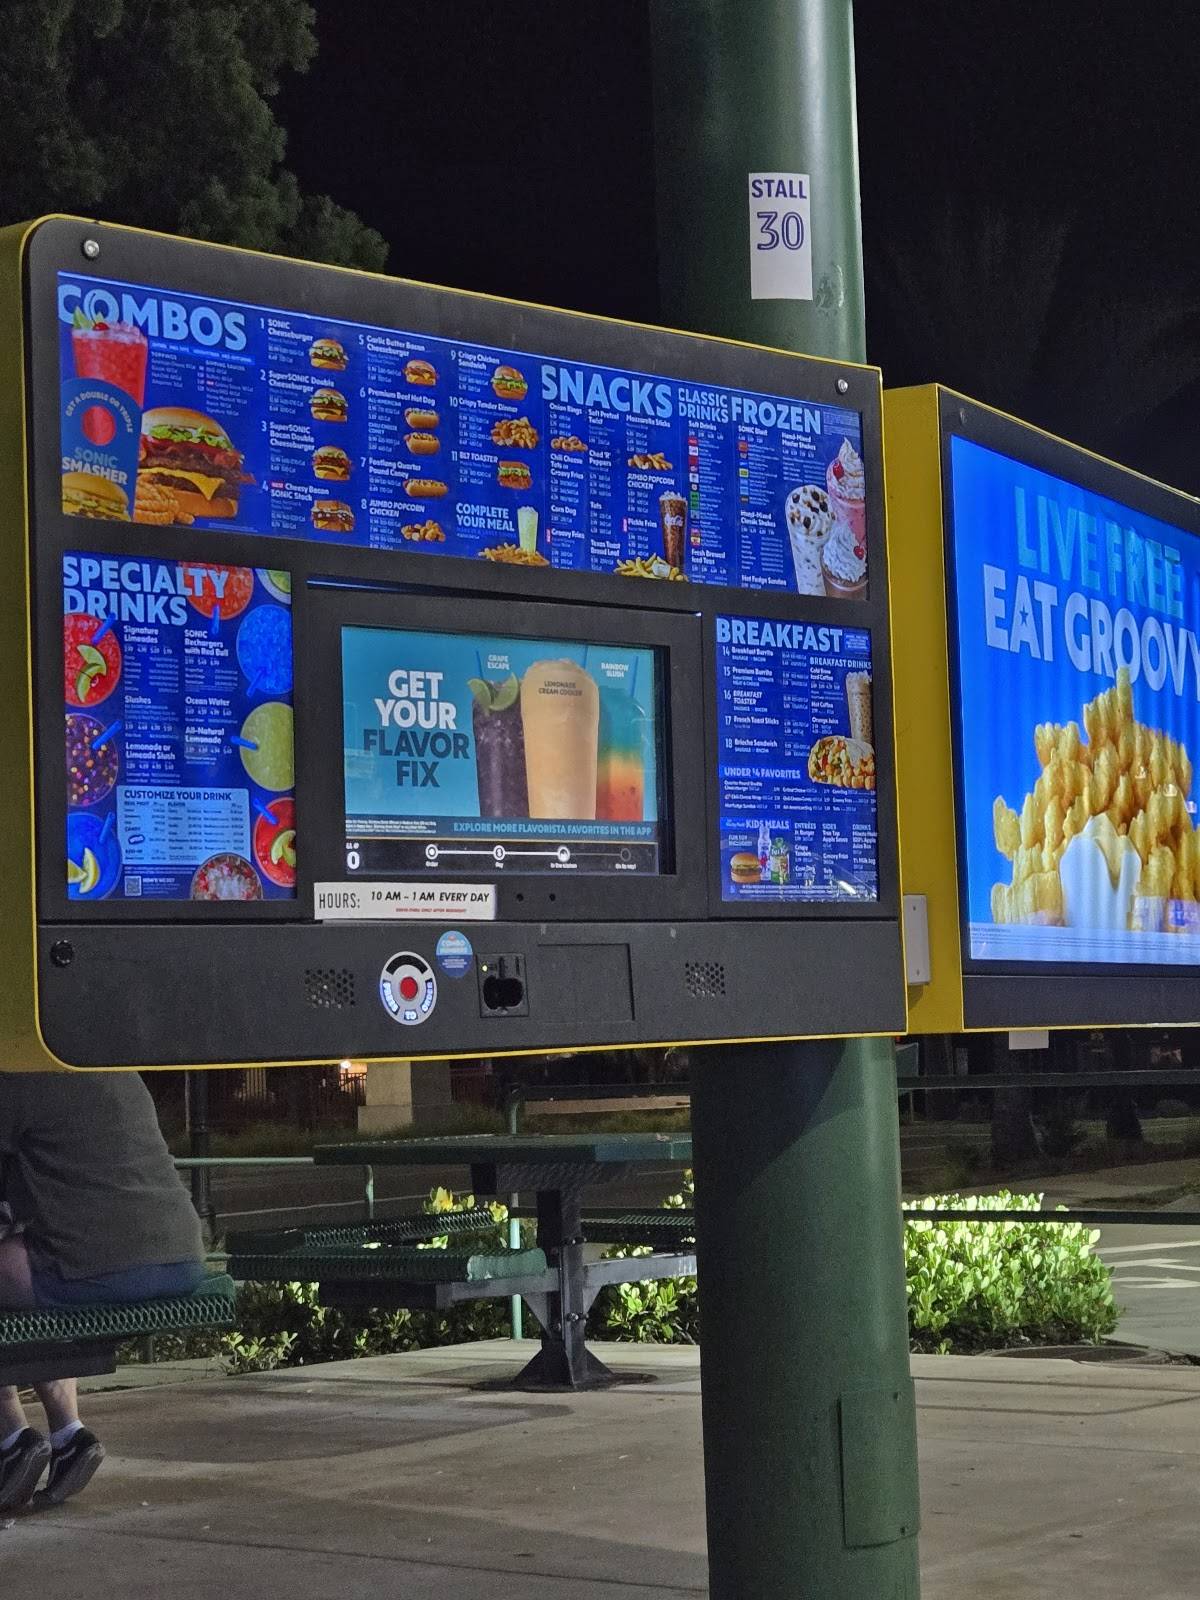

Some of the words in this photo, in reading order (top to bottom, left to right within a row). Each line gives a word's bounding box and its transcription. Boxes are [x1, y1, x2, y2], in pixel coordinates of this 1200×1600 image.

[752, 179, 806, 198] STALL
[757, 212, 804, 250] 30
[58, 284, 246, 350] COMBOS
[260, 318, 264, 329] 1
[268, 319, 290, 329] SONIC
[359, 334, 364, 345] 5
[451, 350, 456, 360] 9
[260, 369, 266, 380] 2
[80, 391, 110, 401] DOUBLE
[360, 387, 366, 397] 6
[542, 365, 672, 418] SNACKS
[449, 396, 458, 407] 10
[678, 388, 728, 408] CLASSIC
[679, 401, 728, 423] DRINKS
[731, 397, 820, 434] FROZEN
[262, 421, 267, 432] 3
[270, 422, 310, 434] SuperSONIC
[74, 447, 118, 469] SONIC
[360, 457, 366, 467] 7
[451, 451, 457, 461] 11
[471, 453, 498, 463] TOASTER
[62, 456, 128, 486] SMASHER
[262, 480, 268, 491] 4
[627, 481, 653, 490] CHICKEN
[648, 476, 675, 485] POPCORN
[271, 489, 293, 499] SONIC
[361, 499, 367, 509] 8
[369, 500, 392, 508] JUMBO
[394, 502, 425, 512] POPCORN
[456, 503, 509, 519] COMPLETE
[370, 508, 399, 517] CHICKEN
[456, 514, 486, 528] YOUR
[487, 519, 515, 532] MEAL
[1014, 486, 1100, 590] LIVE
[1105, 520, 1184, 620] FREE
[63, 556, 229, 598] SPECIALTY
[64, 588, 188, 626] DRINKS
[984, 564, 1058, 662] EAT
[124, 626, 159, 635] Signature
[184, 629, 208, 638] SONIC
[716, 618, 842, 652] BREAKFAST
[124, 635, 158, 643] Limeades
[185, 639, 223, 648] Rechargers
[723, 646, 730, 656] 14
[731, 647, 756, 655] Breakfast
[487, 662, 510, 670] ESCAPE
[601, 663, 629, 672] RAINBOW
[810, 657, 847, 667] BREAKFAST
[848, 661, 871, 670] DRINKS
[724, 666, 730, 676] 15
[389, 670, 443, 699] GET
[544, 681, 576, 689] LEMONADE
[124, 696, 151, 704] Slushes
[724, 690, 731, 700] 16
[733, 690, 762, 698] BREAKFAST
[185, 697, 208, 705] Ocean
[209, 698, 230, 706] Water
[375, 699, 456, 729] YOUR
[725, 716, 732, 725] 17
[185, 726, 224, 735] All-Natural
[185, 735, 222, 744] Lemonade
[363, 729, 470, 759] FLAVOR
[725, 738, 732, 748] 18
[126, 742, 162, 751] Lemonade
[126, 751, 156, 759] Limeade
[157, 752, 175, 760] Slush
[397, 761, 440, 787] FIX
[724, 767, 751, 776] UNDER
[753, 768, 760, 777] $4
[761, 768, 800, 778] FAVORITES
[124, 790, 174, 800] CUSTOMIZE
[176, 791, 200, 800] YOUR
[203, 792, 232, 800] DRINK
[454, 822, 491, 832] EXPLORE
[493, 824, 517, 832] MORE
[519, 824, 565, 834] FLAVORISTA
[567, 825, 610, 834] FAVORITES
[611, 826, 619, 834] IN
[620, 826, 635, 835] THE
[637, 826, 651, 835] APP
[746, 820, 763, 828] KIDS
[765, 820, 789, 829] MEALS
[319, 893, 360, 909] HOURS:
[371, 892, 382, 900] 10
[385, 892, 401, 900] AM
[413, 892, 416, 901] 1
[420, 892, 435, 901] AM
[439, 892, 468, 901] EVERY
[470, 893, 489, 902] DAY
